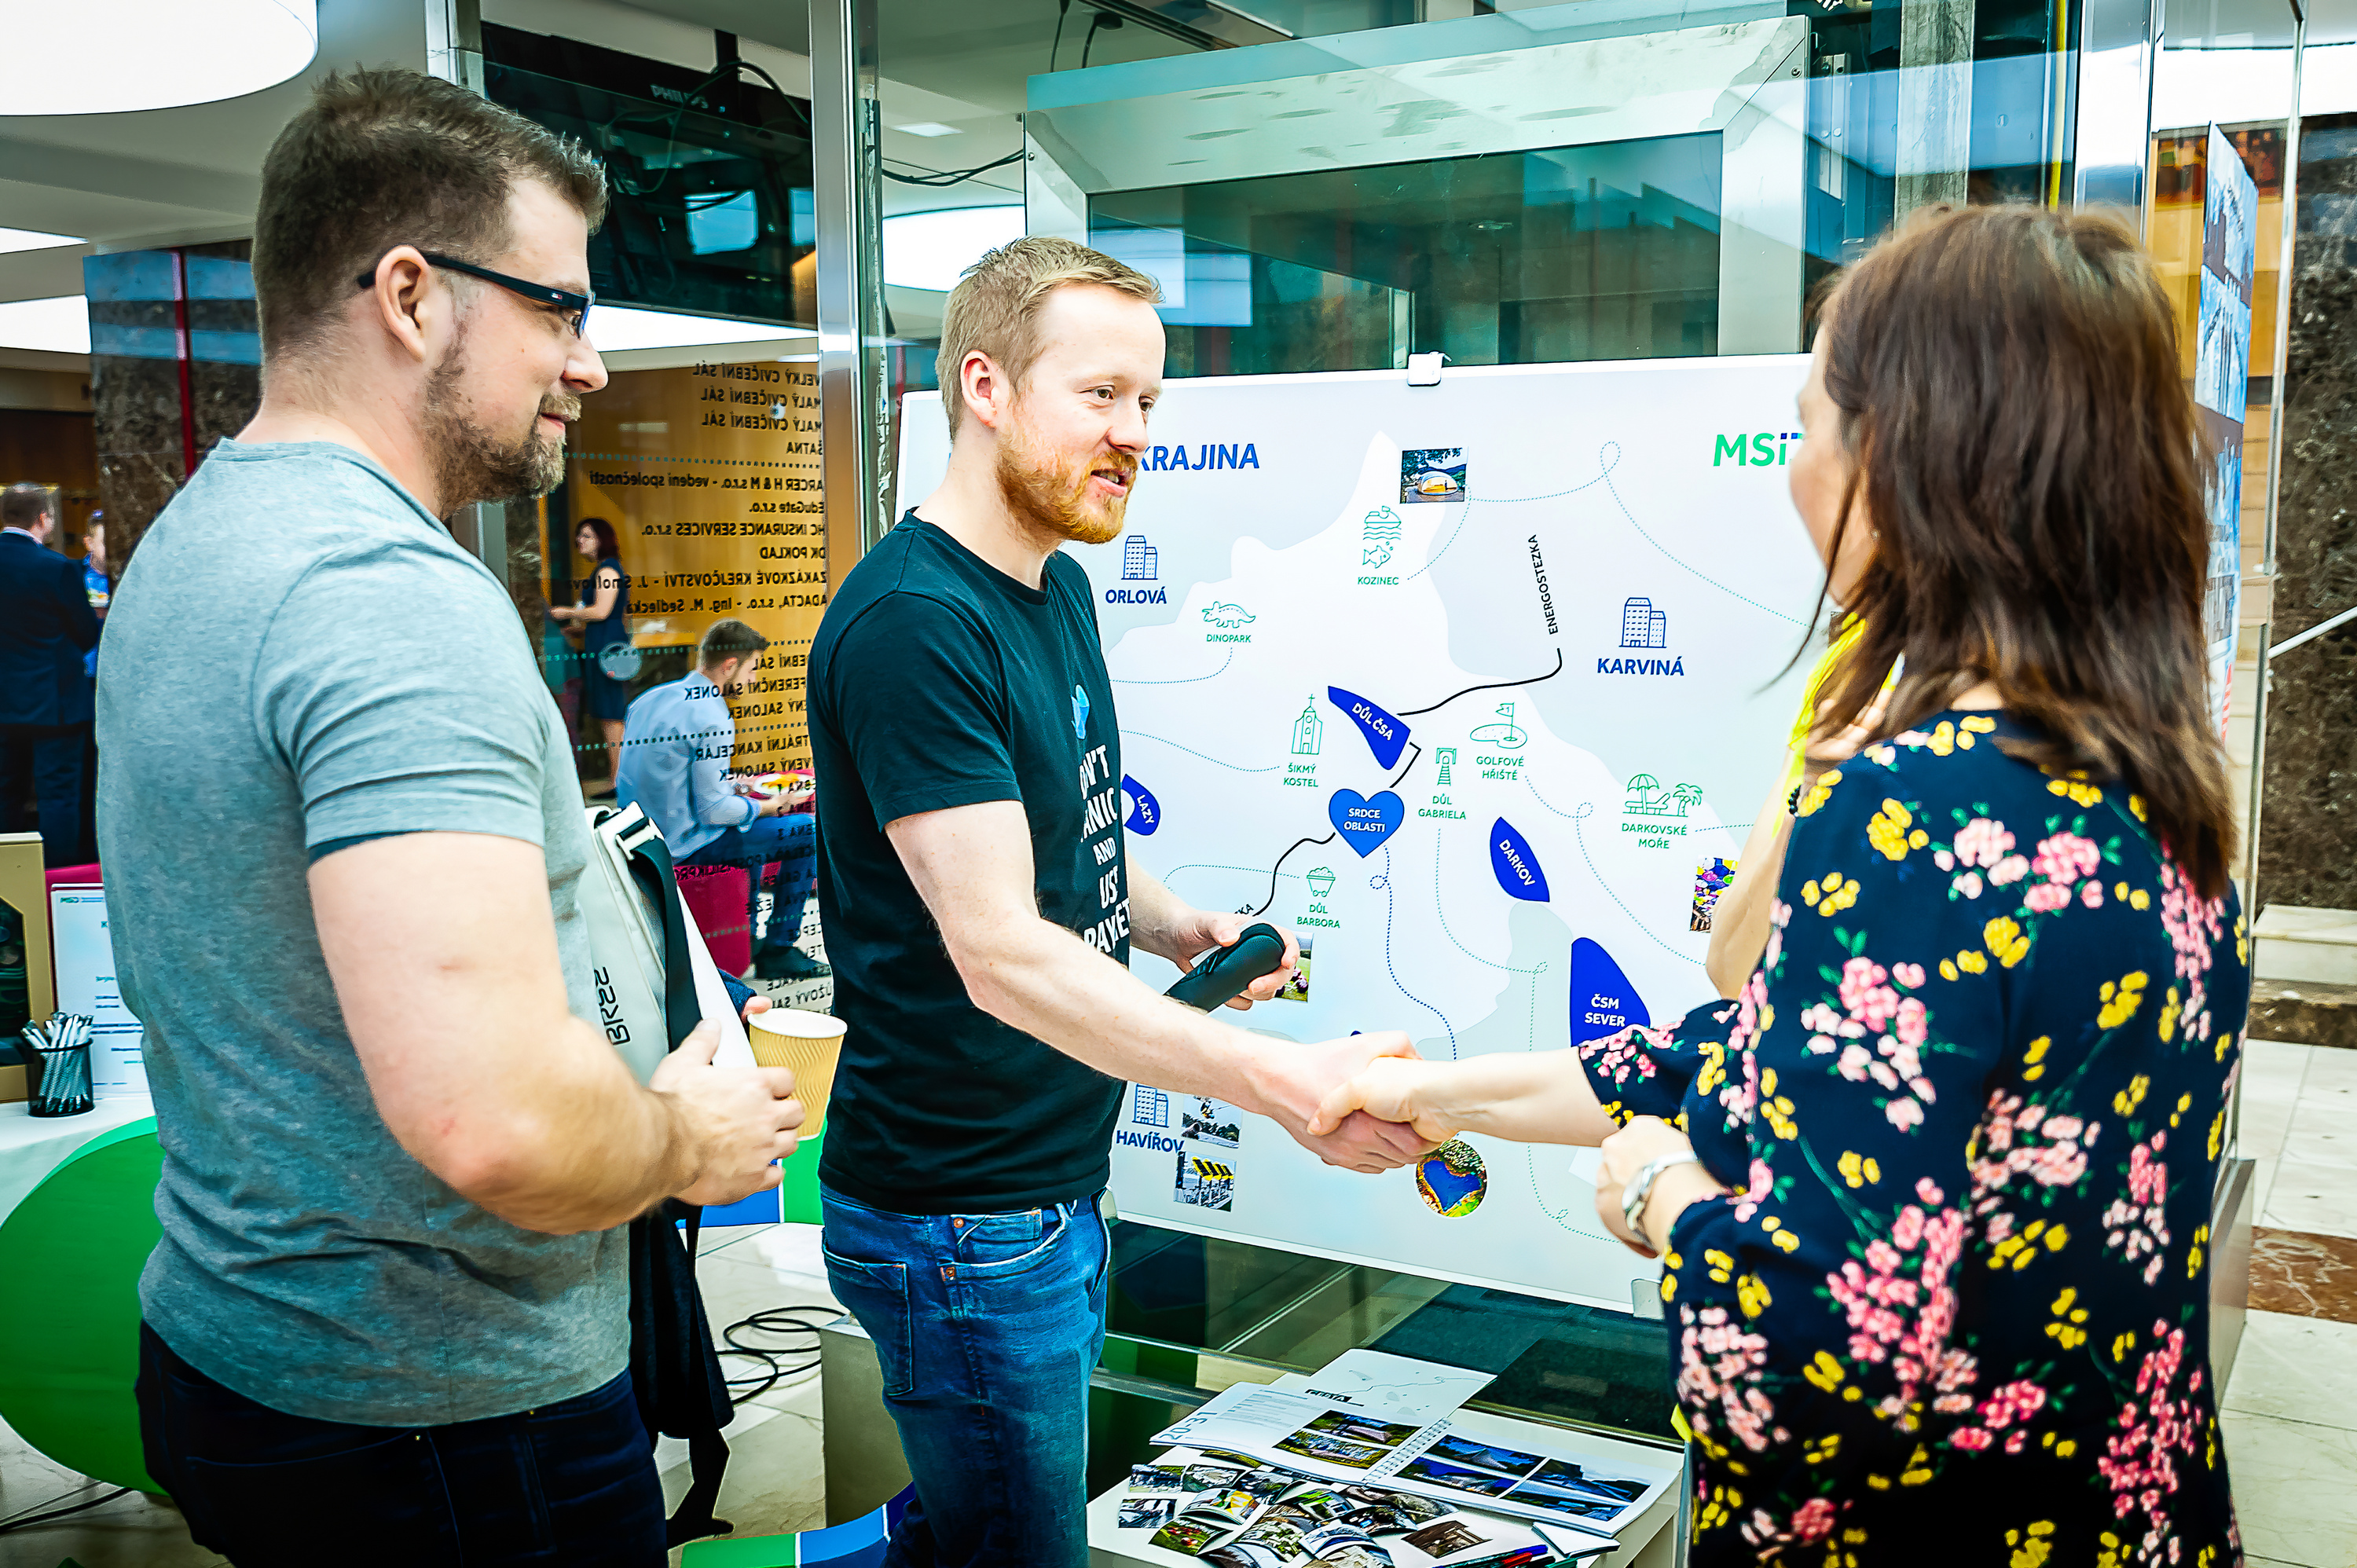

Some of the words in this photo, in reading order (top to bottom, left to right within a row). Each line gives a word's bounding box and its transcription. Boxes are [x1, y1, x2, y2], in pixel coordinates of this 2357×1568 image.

[1357, 576, 1399, 586] KOZINEC
[1527, 533, 1559, 636] ENERGOSTEZKA
[1105, 585, 1168, 605] ORLOVÁ
[1206, 633, 1252, 643] DINOPARK
[1596, 655, 1685, 676] KARVINÁ
[1352, 702, 1373, 725] DŮL
[1372, 717, 1393, 741] ČSA
[1287, 762, 1317, 775] ŠIKMÝ
[1476, 756, 1524, 767] GOLFOVÉ
[1080, 744, 1110, 800] ON'T
[1283, 777, 1319, 788] KOSTEL
[1431, 793, 1453, 805] DŮL
[1080, 787, 1117, 843] ANIC
[1137, 794, 1155, 823] LAZY
[1348, 808, 1380, 819] SRDCE
[1417, 808, 1467, 820] GABRIELA
[1343, 821, 1385, 833] OBLASTI
[1622, 822, 1688, 836] DARKOVSKÉ
[1638, 838, 1670, 849] MOŘE
[1093, 837, 1116, 866] AND
[1499, 839, 1536, 887] DARKOV
[1099, 865, 1118, 910] US
[1308, 902, 1329, 914] DŮL
[1296, 916, 1341, 929] BARBORA
[1591, 993, 1619, 1009] ČSM
[1584, 1012, 1626, 1027] SEVER
[1116, 1130, 1185, 1153] HAVÍŘOV
